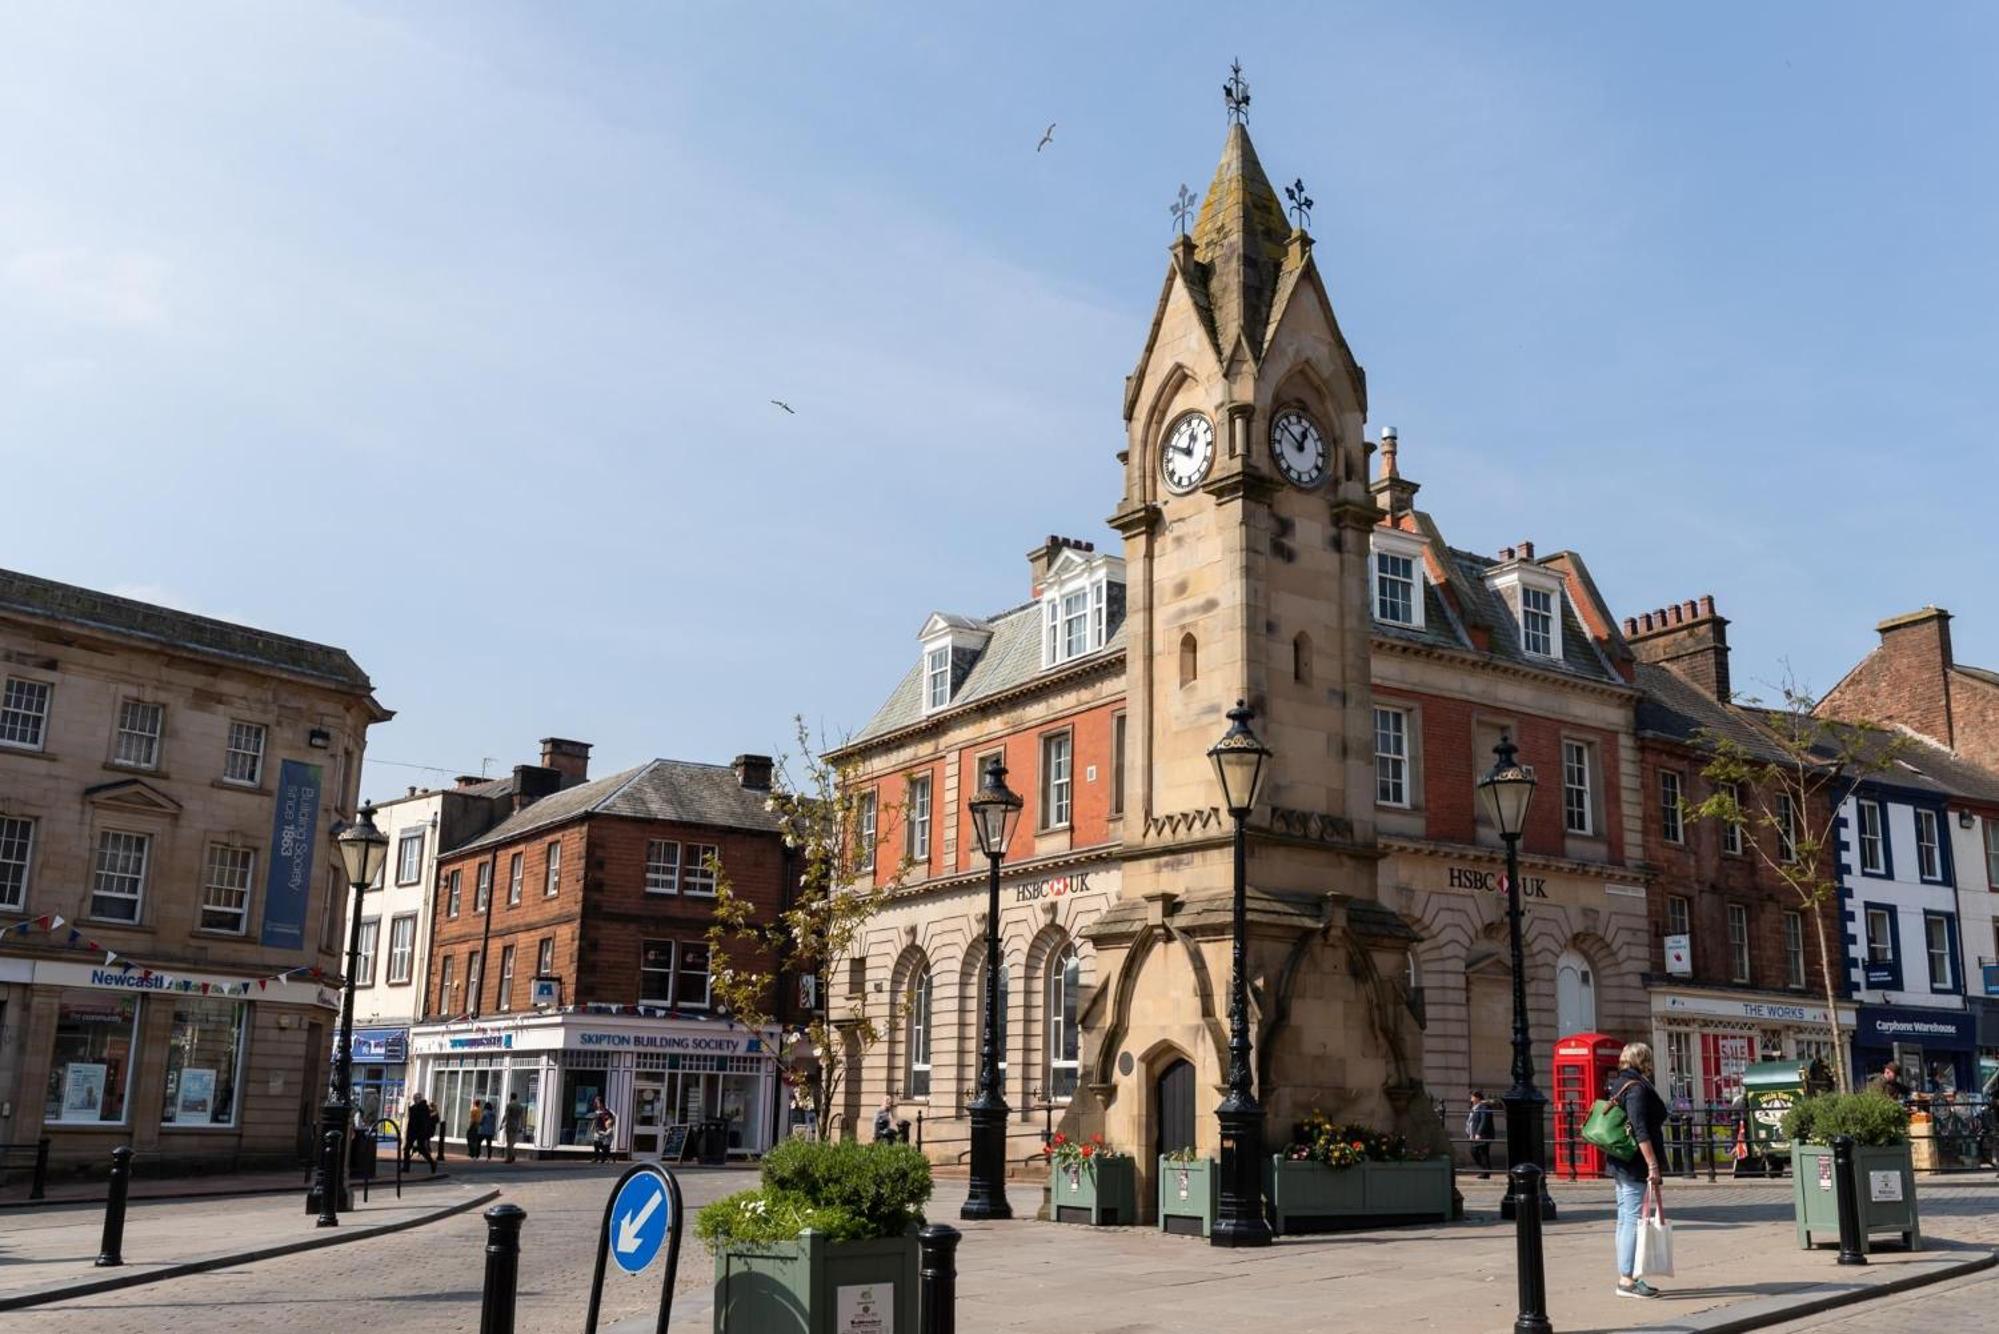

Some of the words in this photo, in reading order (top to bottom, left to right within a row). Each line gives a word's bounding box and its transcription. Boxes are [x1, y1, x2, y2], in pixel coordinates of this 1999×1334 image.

[284, 785, 298, 821] since
[294, 787, 314, 839] Building
[281, 824, 295, 857] 1863
[288, 842, 308, 891] Society
[1016, 880, 1049, 902] HSBC
[1069, 873, 1090, 893] UK
[1448, 867, 1495, 892] HSBC
[1522, 877, 1548, 898] UK
[1743, 1003, 1763, 1016] THE
[1766, 1006, 1805, 1020] WORKS
[1876, 1020, 1913, 1034] Carphone
[1914, 1022, 1957, 1034] Warehouse
[580, 1033, 631, 1046] SKIPTON
[634, 1036, 690, 1049] BUILDING
[692, 1038, 739, 1052] SOCIETY
